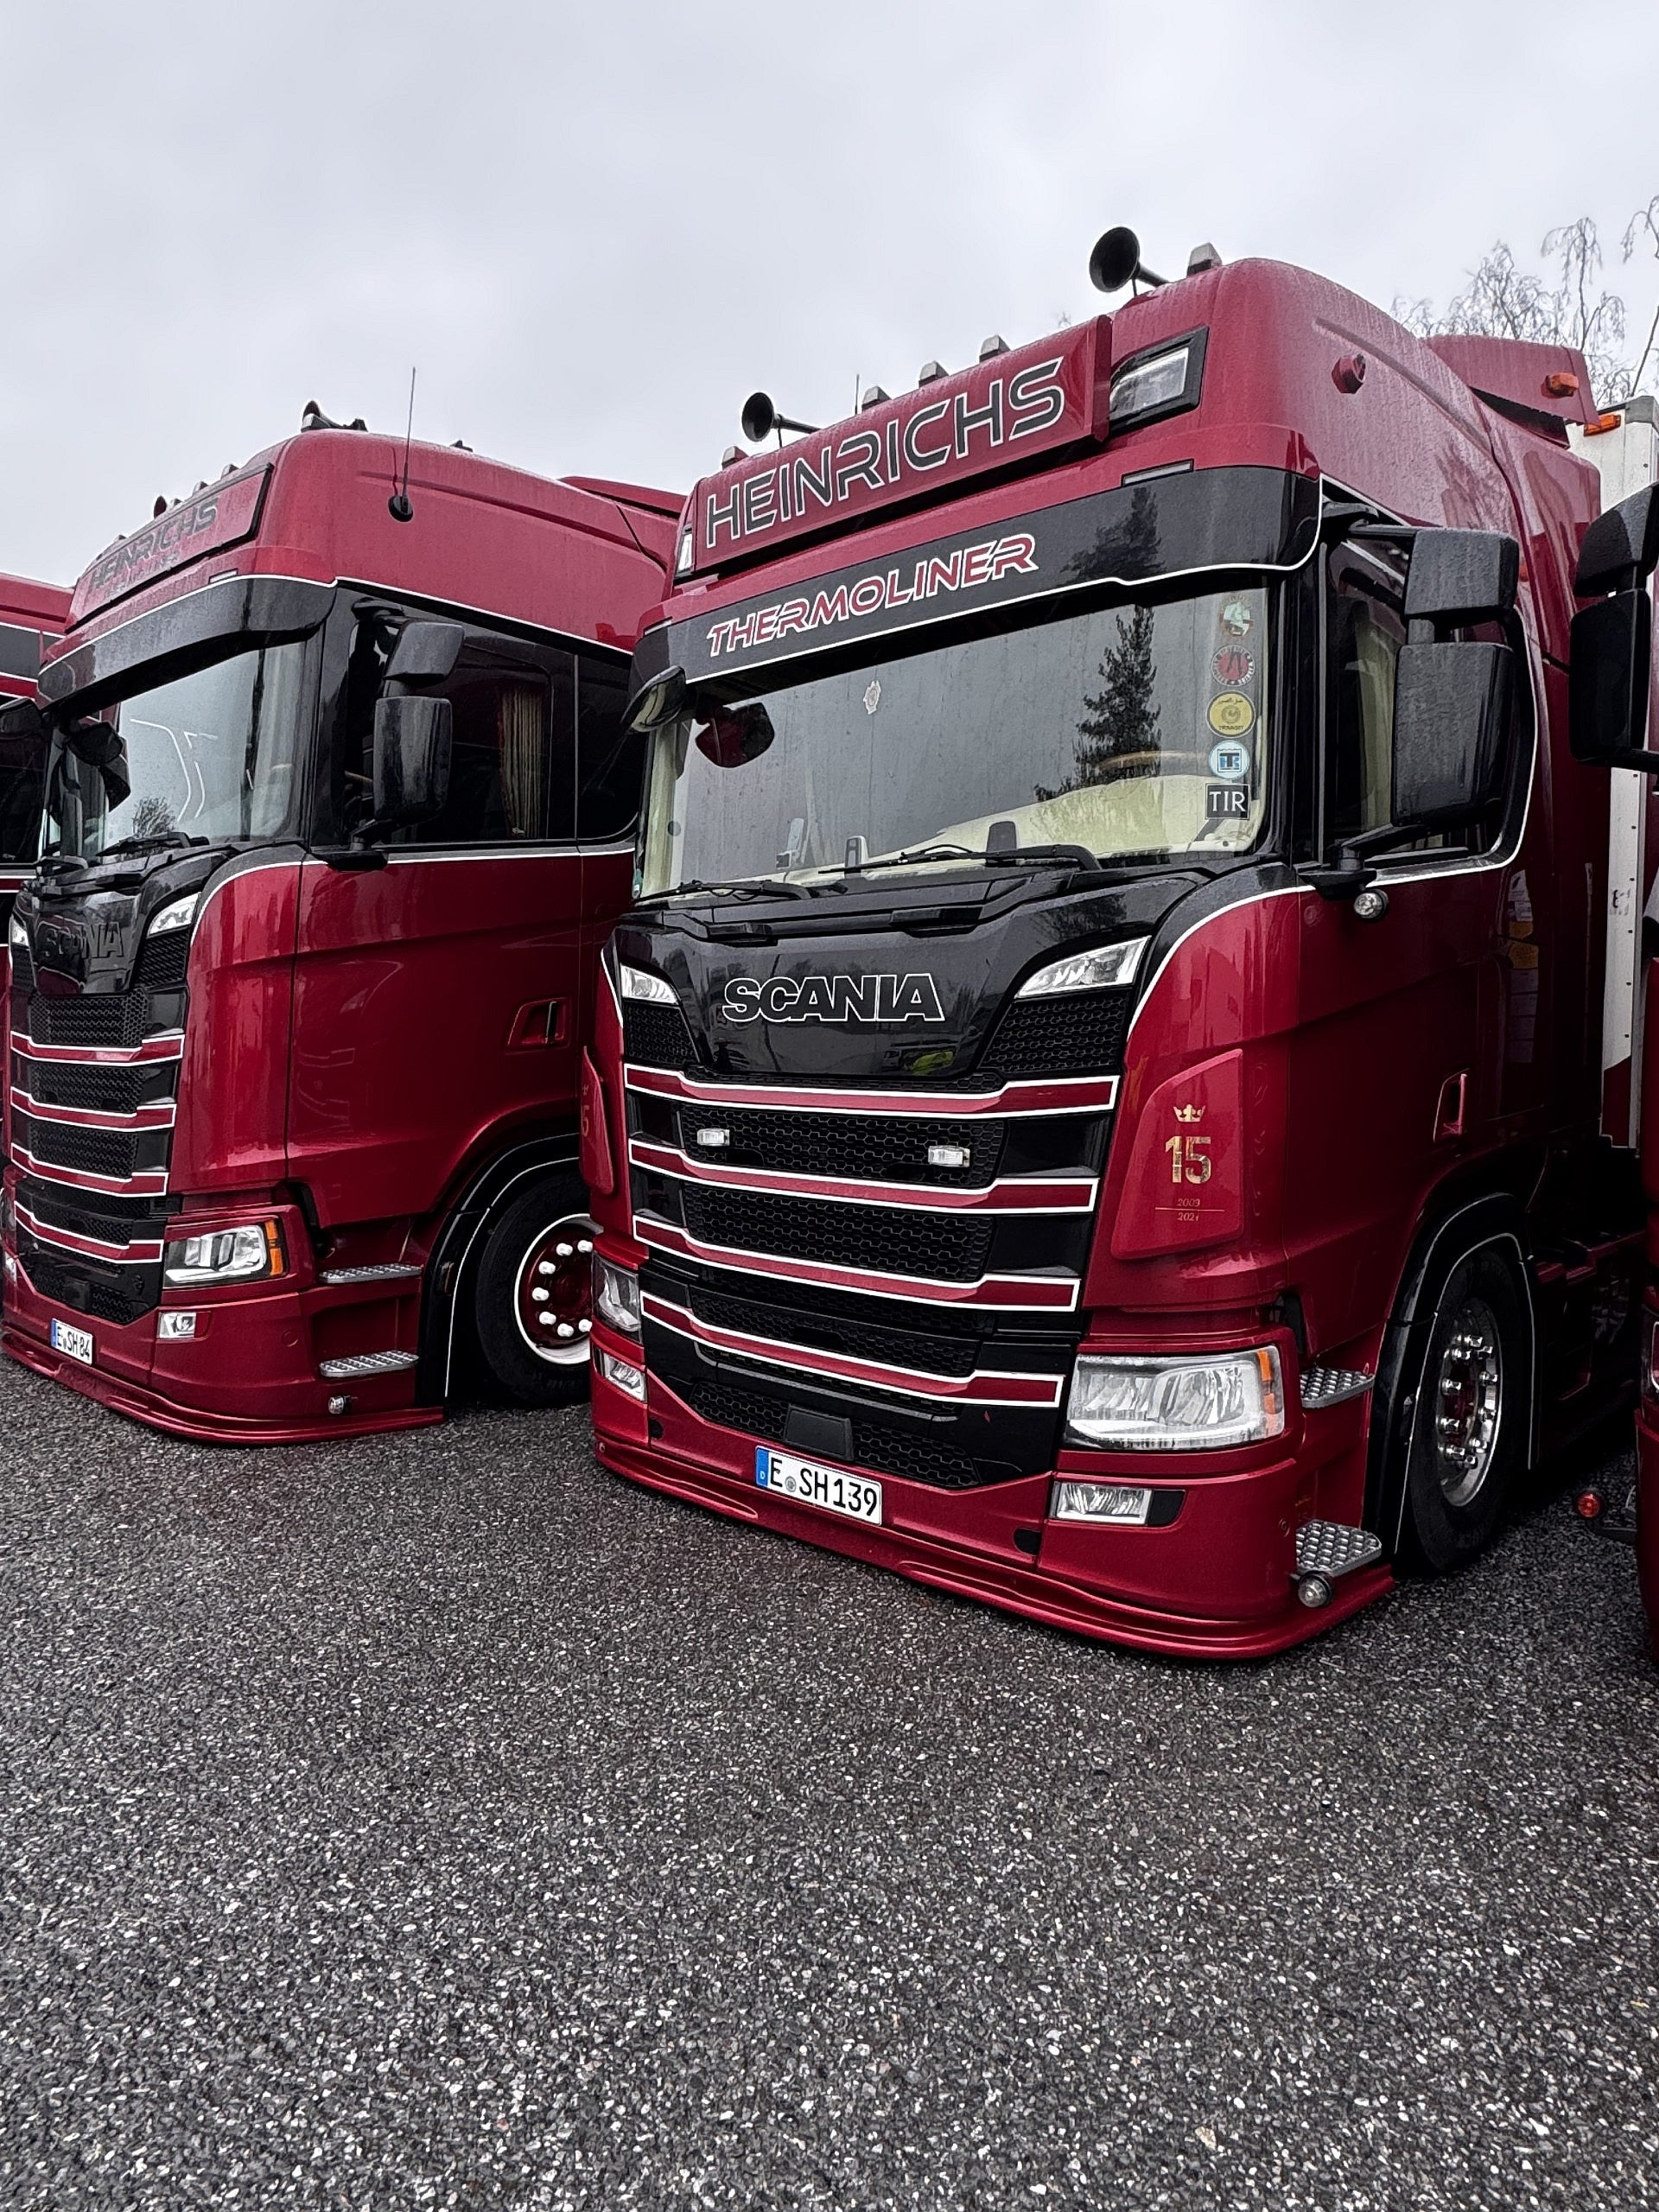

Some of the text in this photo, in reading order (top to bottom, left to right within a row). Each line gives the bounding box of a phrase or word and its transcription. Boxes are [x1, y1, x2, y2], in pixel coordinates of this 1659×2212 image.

[706, 356, 1065, 548] HEINRICHS
[706, 533, 1039, 658] THERMOLINER
[1209, 791, 1247, 812] TIR
[722, 973, 946, 1023] SCANIA
[1165, 1135, 1211, 1185] 15
